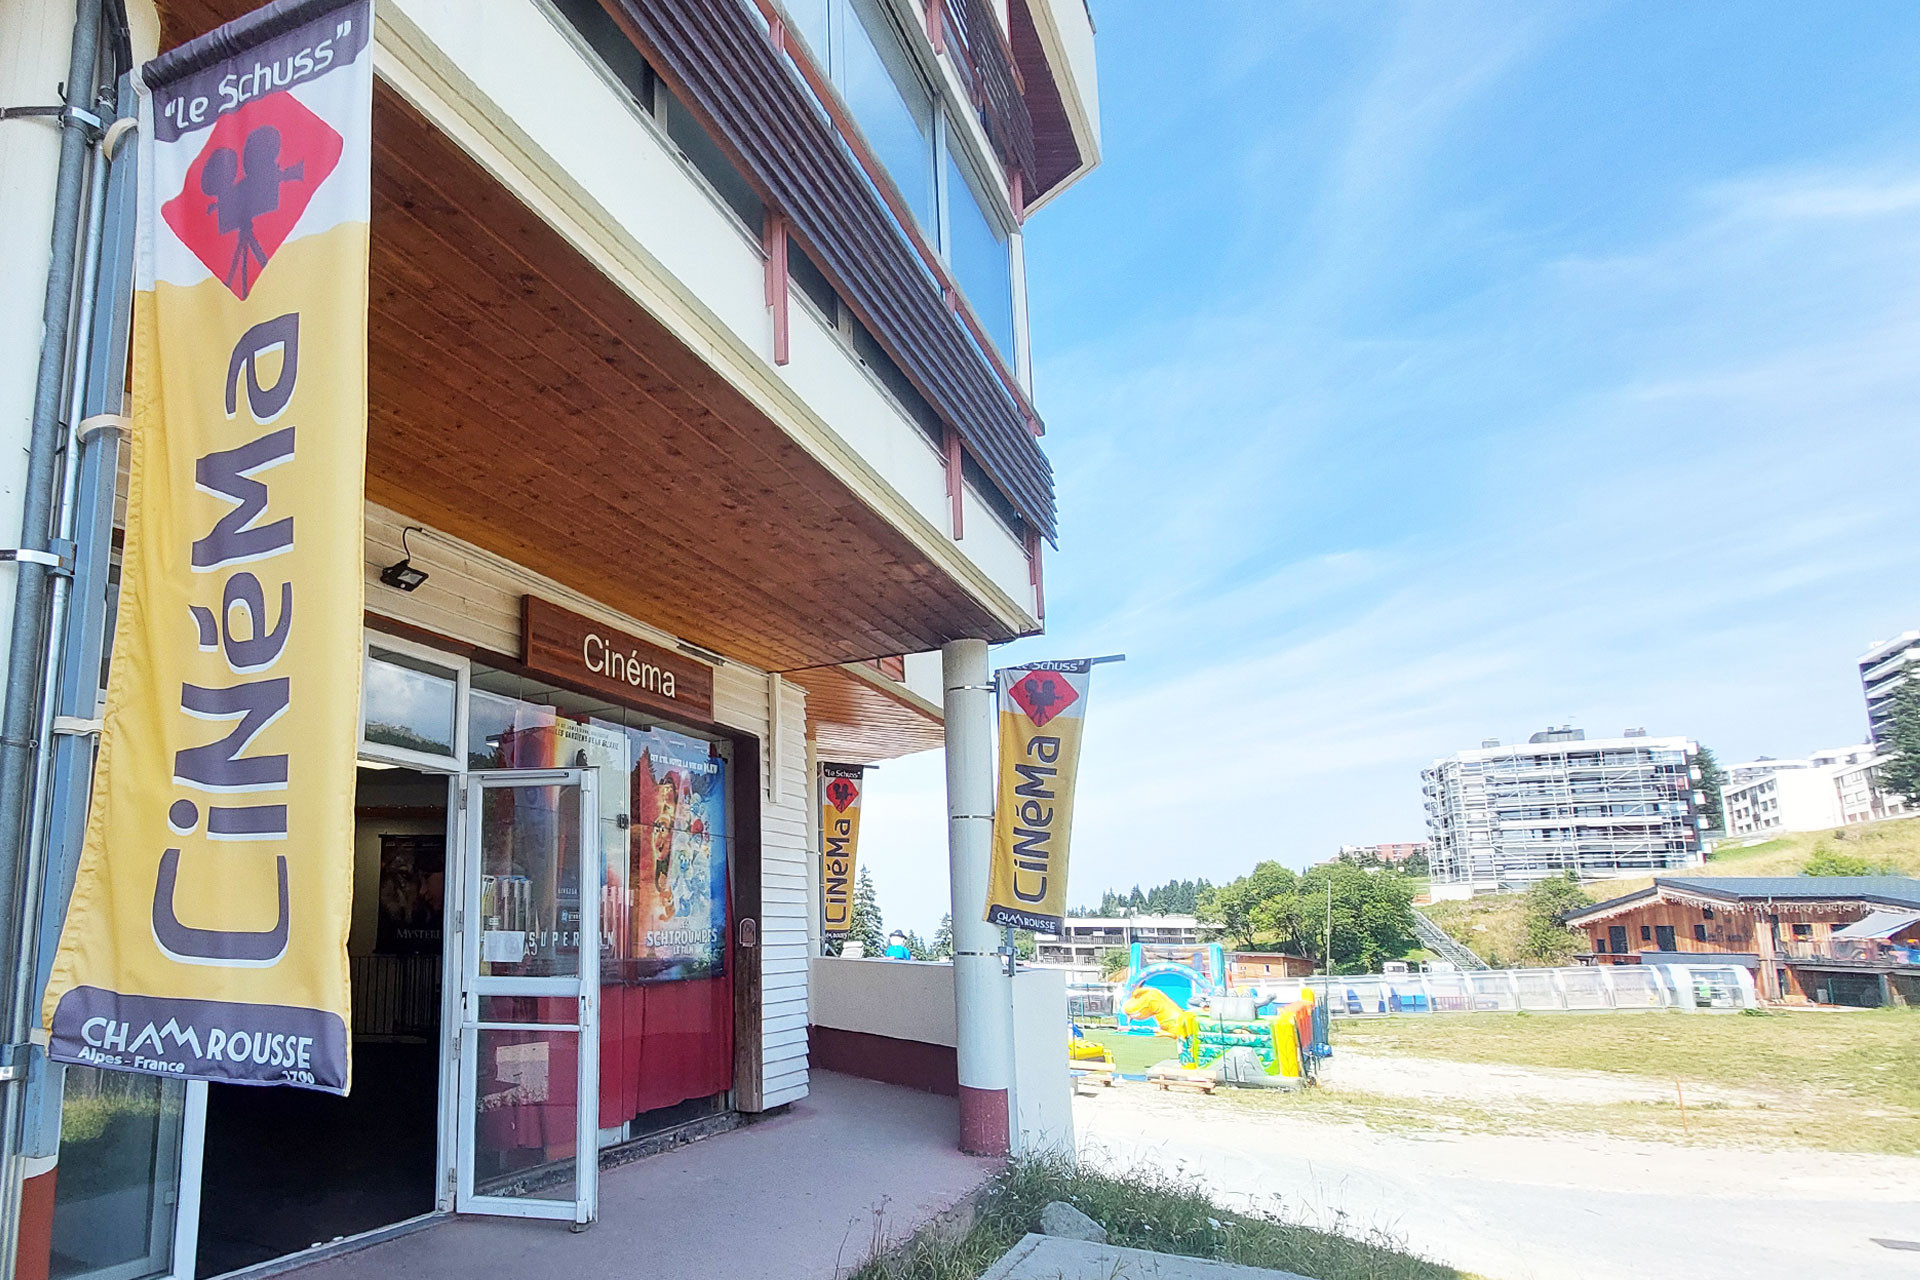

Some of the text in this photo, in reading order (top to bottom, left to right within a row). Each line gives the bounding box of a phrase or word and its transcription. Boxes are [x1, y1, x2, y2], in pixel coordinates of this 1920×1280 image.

[583, 633, 676, 698] Cinéma
[645, 927, 719, 948] SCHTROUMPFS
[77, 1046, 123, 1068] Alpes
[133, 1055, 186, 1075] France
[80, 1016, 314, 1070] CHAMROUSSE
